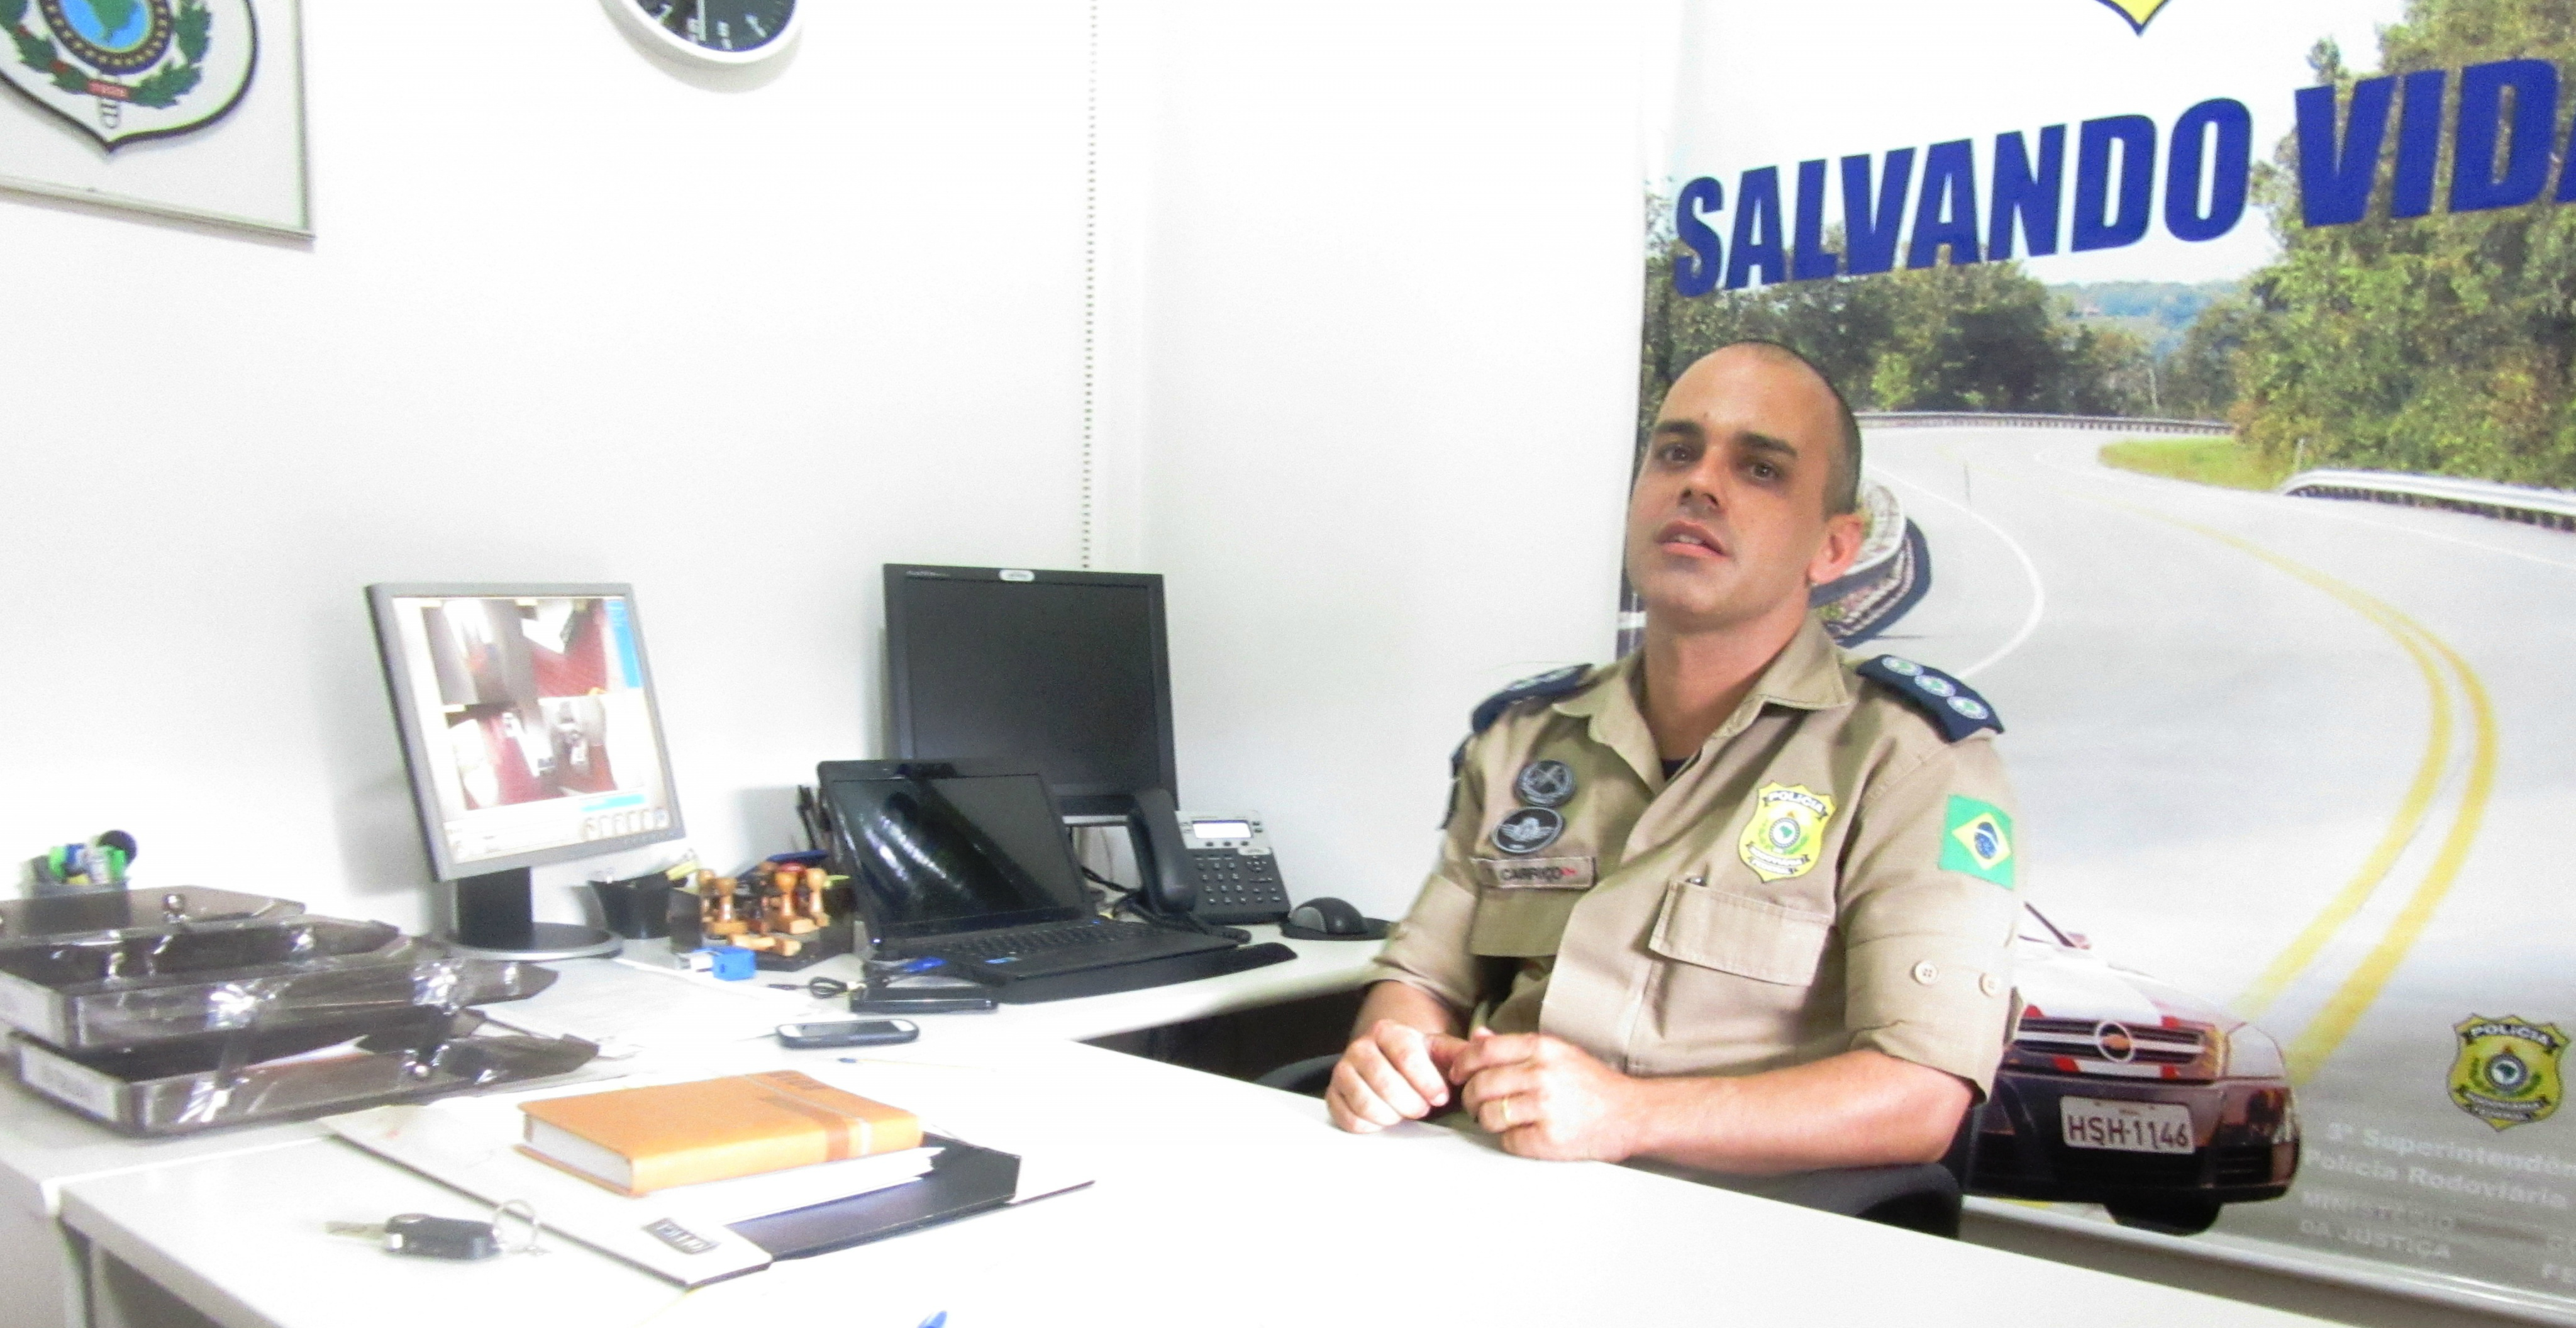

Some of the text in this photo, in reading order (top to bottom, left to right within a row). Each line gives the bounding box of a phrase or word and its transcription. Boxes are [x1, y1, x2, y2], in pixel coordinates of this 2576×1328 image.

[1673, 58, 2576, 298] SALVANDO VID
[2067, 1114, 2188, 1149] HSH-1146
